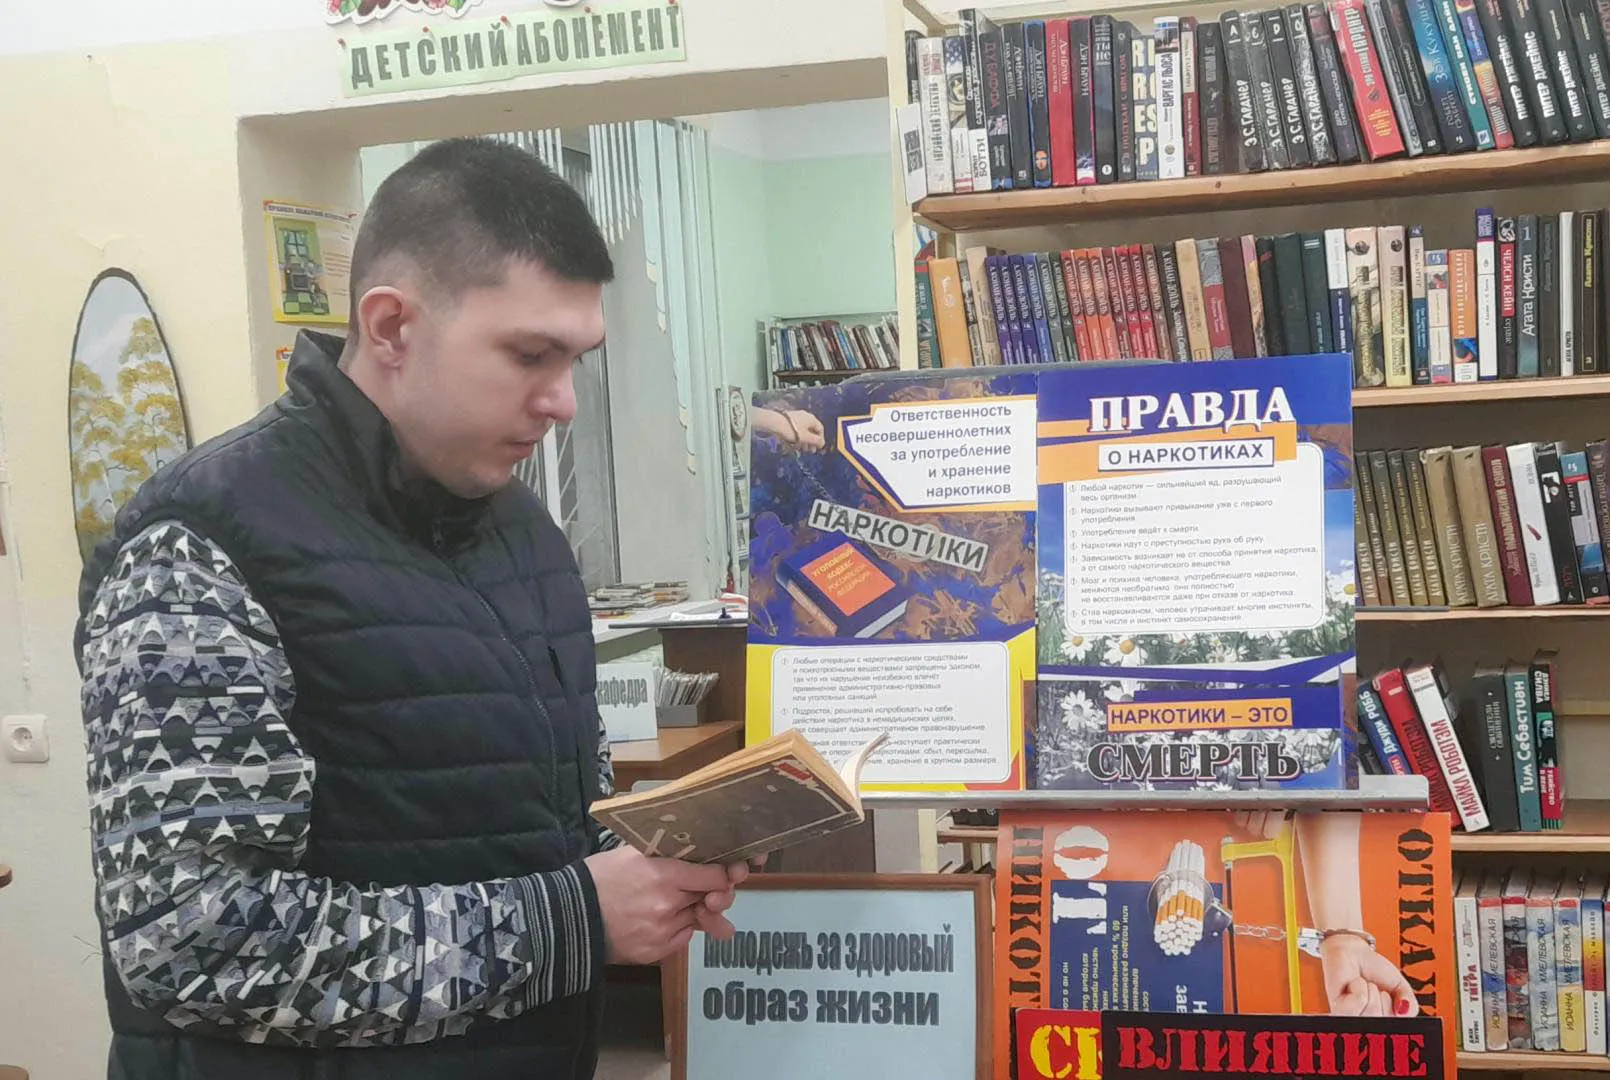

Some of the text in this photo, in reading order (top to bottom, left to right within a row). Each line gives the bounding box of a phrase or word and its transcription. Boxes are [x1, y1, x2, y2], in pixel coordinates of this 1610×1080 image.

[351, 5, 680, 90] ДЕТСКИЙ АБОНЕМЕНТ
[1161, 53, 1174, 107] ВАРГАС ЛЬОСА
[1497, 35, 1528, 120] ПИТЕР ДЖЕЙМС
[1524, 31, 1555, 117] ПИТЕР ДЖЕЙМС
[1557, 50, 1582, 117] ПИТЕР ДЖЕЙМС
[1502, 249, 1512, 283] ЧЕЛСИ
[1522, 254, 1535, 336] Агата Кристи
[891, 405, 1011, 422] Ответственность
[1088, 386, 1296, 433] ПРАВДА
[856, 425, 1011, 444] несовершеннолетних
[890, 444, 1011, 463] за употребление
[1108, 443, 1264, 465] О НАРКОТИКАХ
[926, 483, 1011, 500] наркотиков
[928, 463, 1011, 482] и хранение
[812, 502, 987, 570] НАРКОТИКИ
[1534, 671, 1544, 703] СИЛВА
[1111, 708, 1226, 725] НАРКОТИКИ
[1248, 707, 1288, 723] ЭТО
[1359, 690, 1398, 754] Джуди РОББ
[1512, 681, 1535, 793] Тим Себастиан
[1087, 742, 1300, 782] СМЕРТЬ
[1430, 719, 1481, 817] МАЙКЛ РОБОТЭМ
[1053, 825, 1109, 935] ОТ
[1009, 826, 1043, 1009] НИКОТ
[817, 932, 841, 971] за
[845, 924, 954, 977] здоровый
[1488, 919, 1500, 1029] ИОАННА ХМЕЛЕВСКАЯ
[703, 981, 940, 1026] образ жизни
[1468, 964, 1479, 1002] ТИГРА
[1564, 992, 1574, 1031] ИОАННА
[1115, 1027, 1427, 1076] ВЛИЯНИЕ
